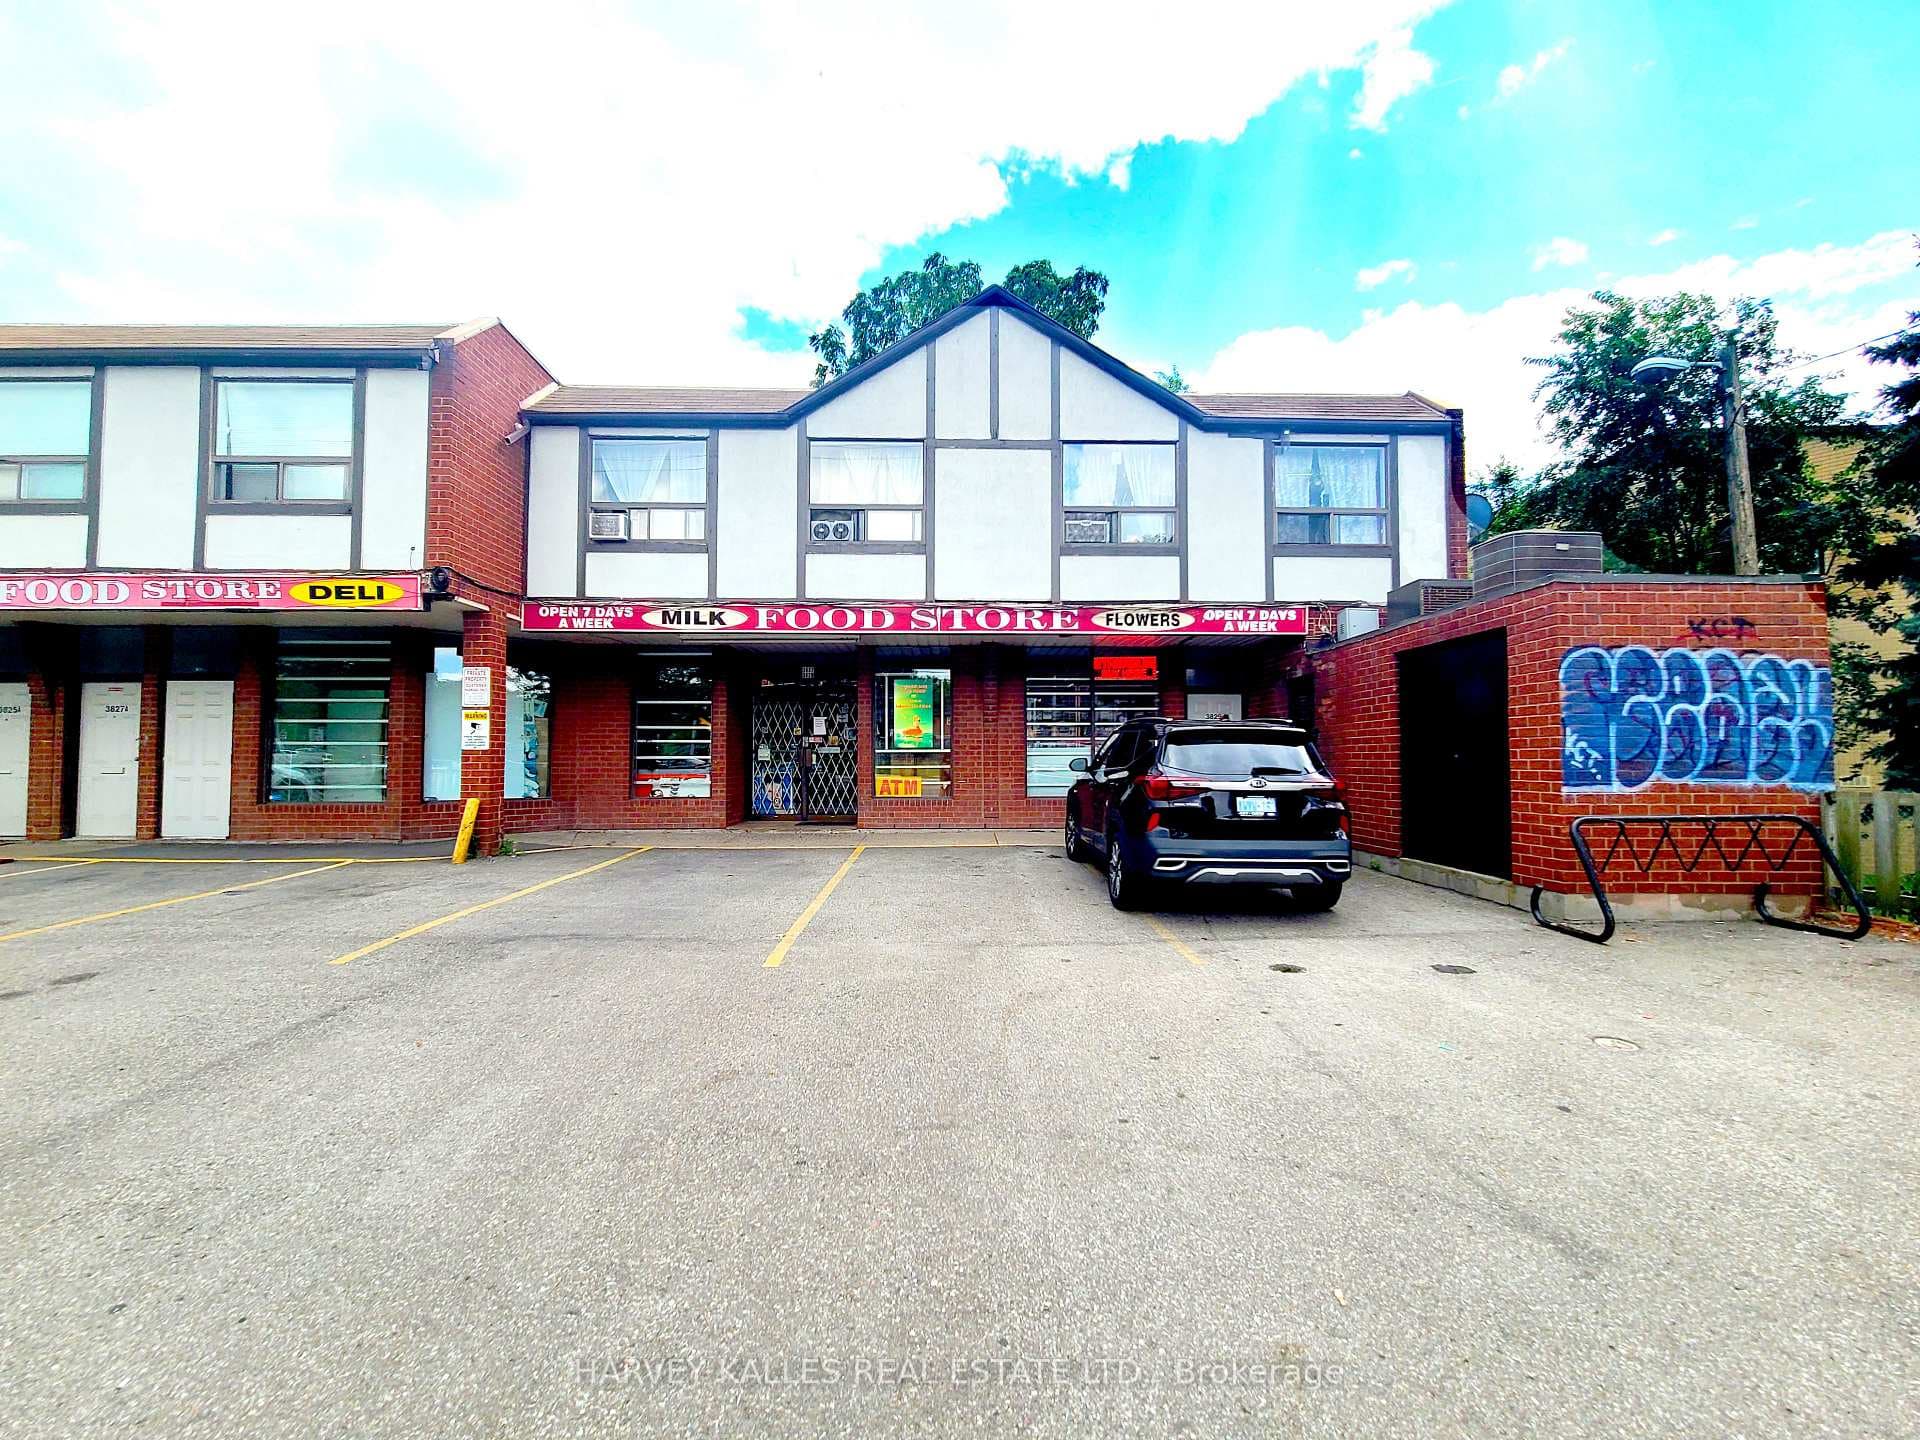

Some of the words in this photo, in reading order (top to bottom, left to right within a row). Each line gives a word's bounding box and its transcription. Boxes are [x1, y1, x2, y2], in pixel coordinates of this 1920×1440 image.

[0, 579, 130, 604] FOOD
[142, 580, 281, 599] STORE
[309, 586, 384, 600] DELI
[538, 606, 578, 617] OPEN
[582, 607, 592, 617] 7
[595, 606, 634, 618] DAYS
[661, 611, 727, 625] MILK
[1204, 609, 1244, 621] OPEN
[1247, 610, 1256, 620] 7
[1259, 609, 1297, 621] DAYS
[558, 618, 568, 628] A
[572, 618, 615, 628] WEEK
[755, 608, 896, 630] FOOD
[910, 608, 1081, 630] STORE
[1105, 613, 1181, 626] FLOWERS
[1224, 621, 1235, 631] A
[1238, 621, 1278, 631] WEEK
[879, 779, 918, 795] ATM
